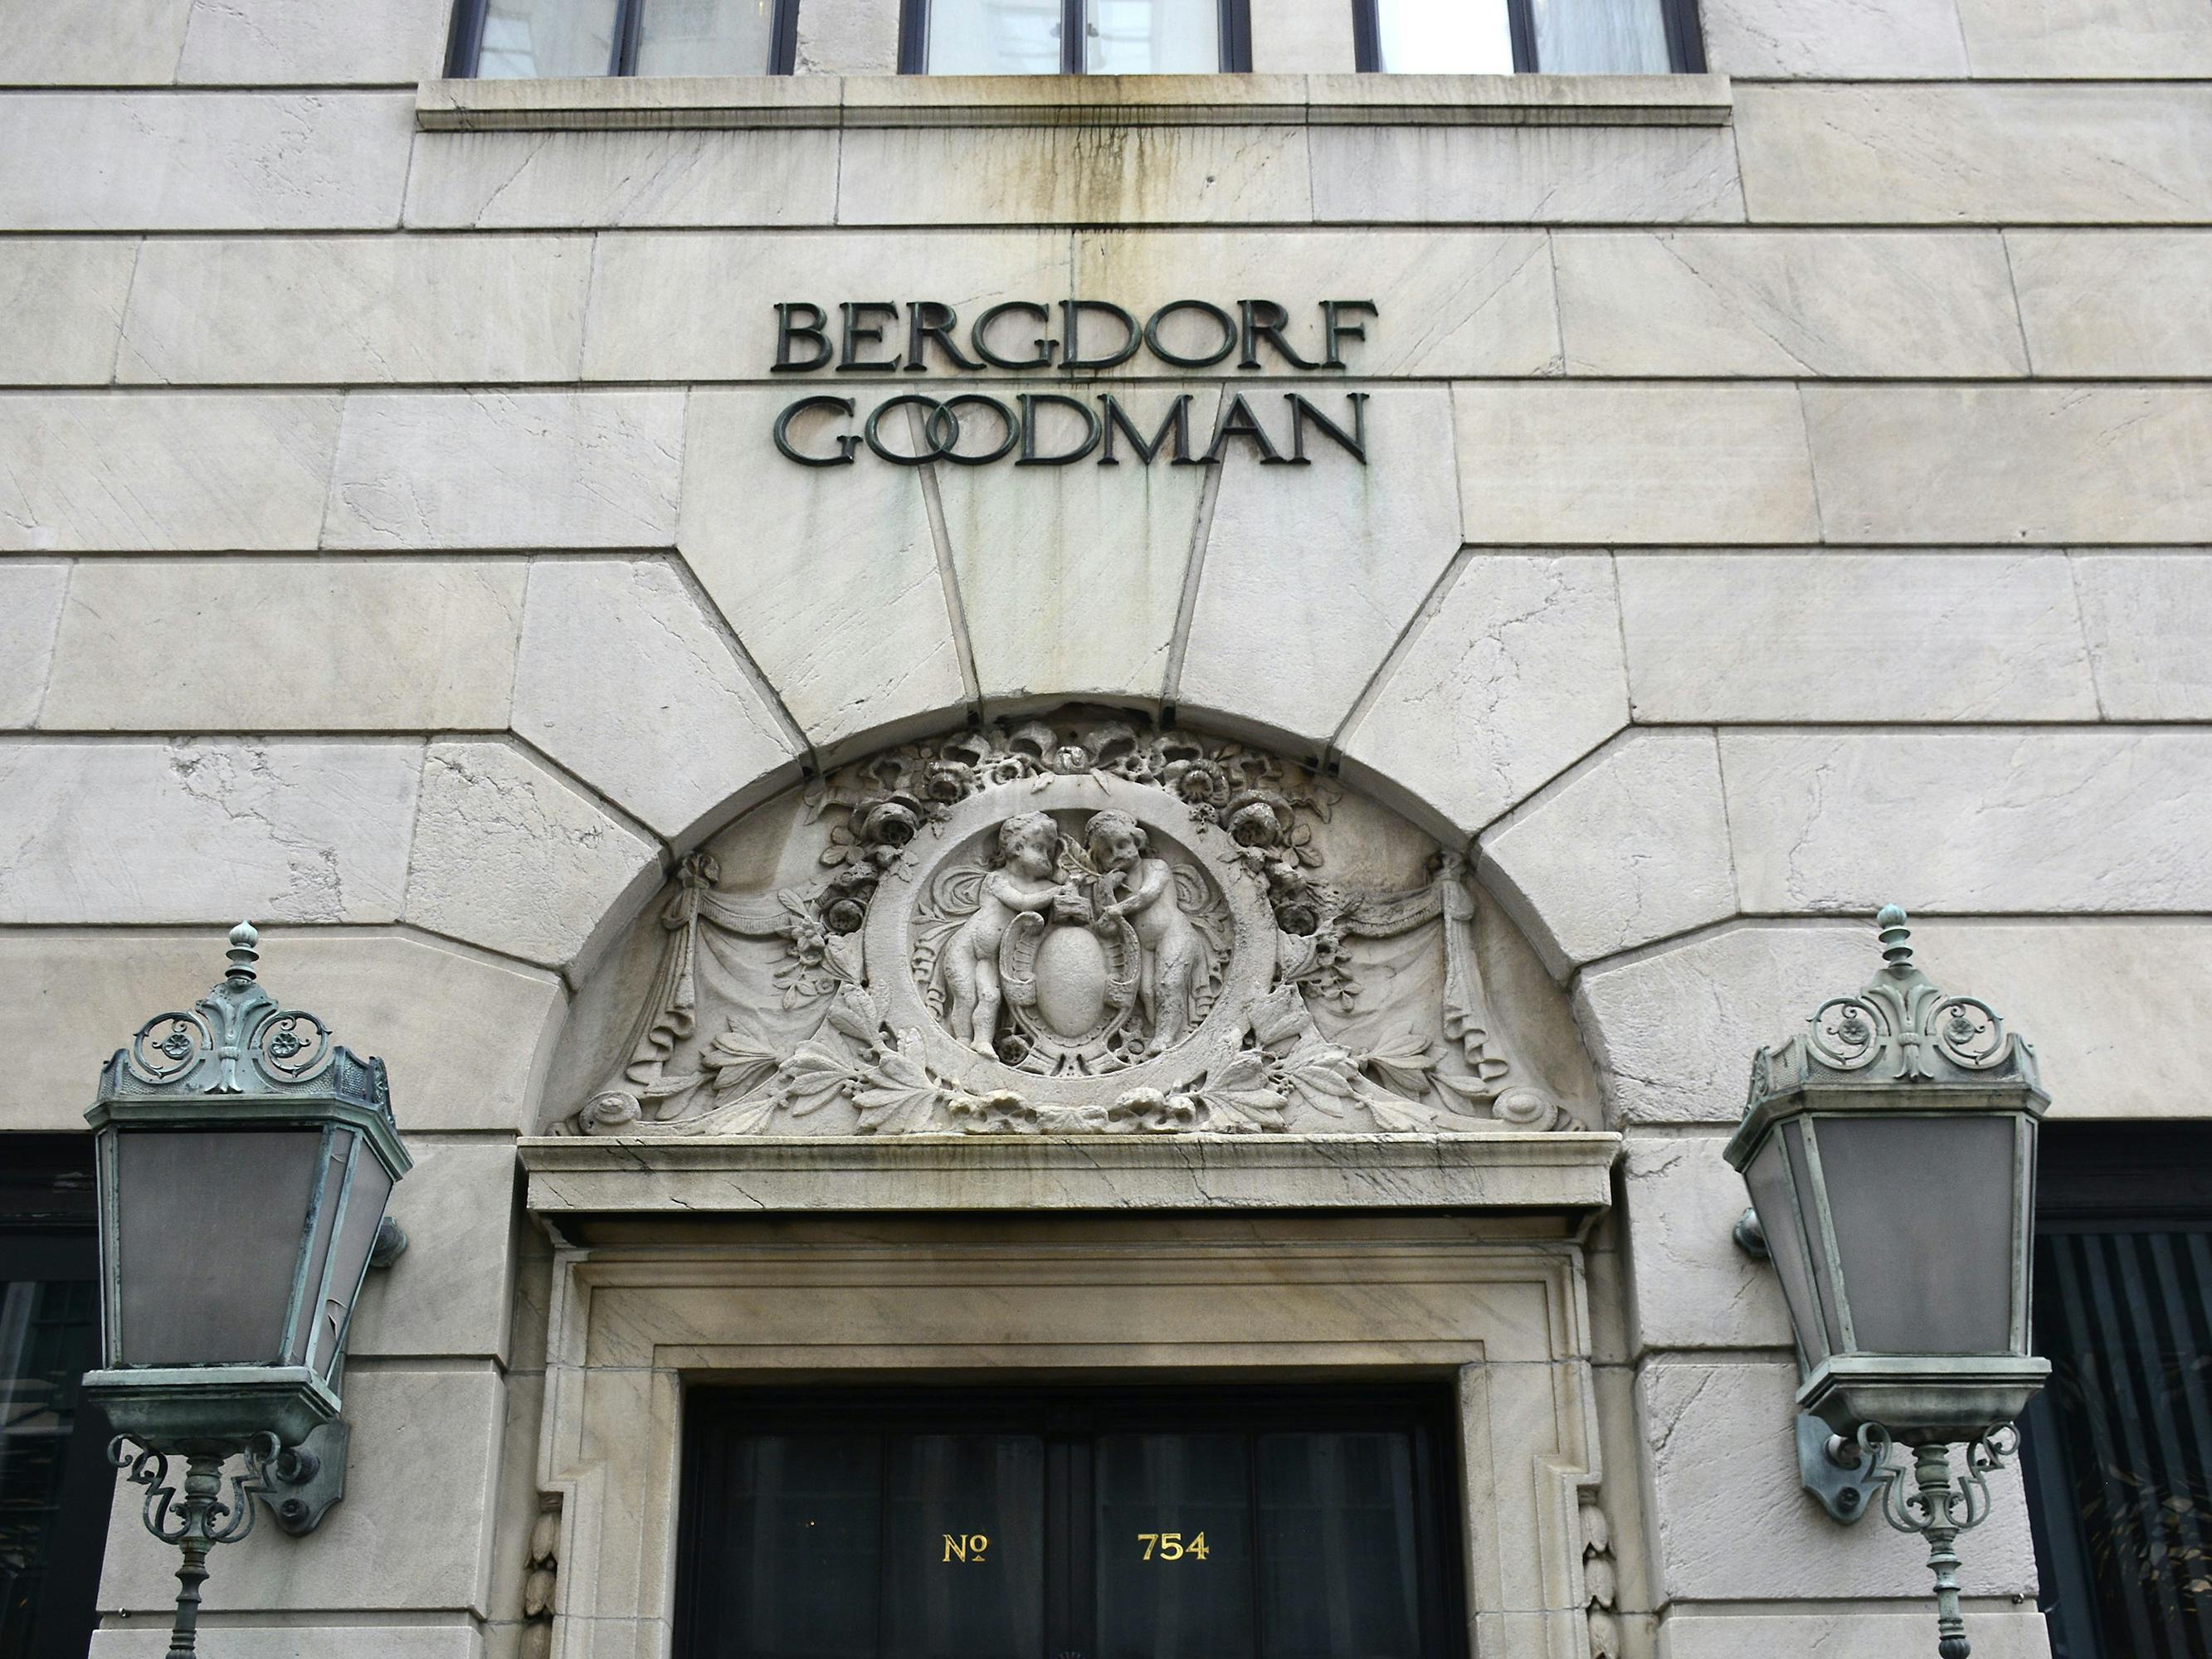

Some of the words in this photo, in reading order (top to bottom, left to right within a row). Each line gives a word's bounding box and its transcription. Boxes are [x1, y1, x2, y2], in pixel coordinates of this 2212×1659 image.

[770, 299, 1379, 372] BERGDORF
[773, 393, 1371, 466] GOODMAN
[1137, 1531, 1210, 1560] 754
